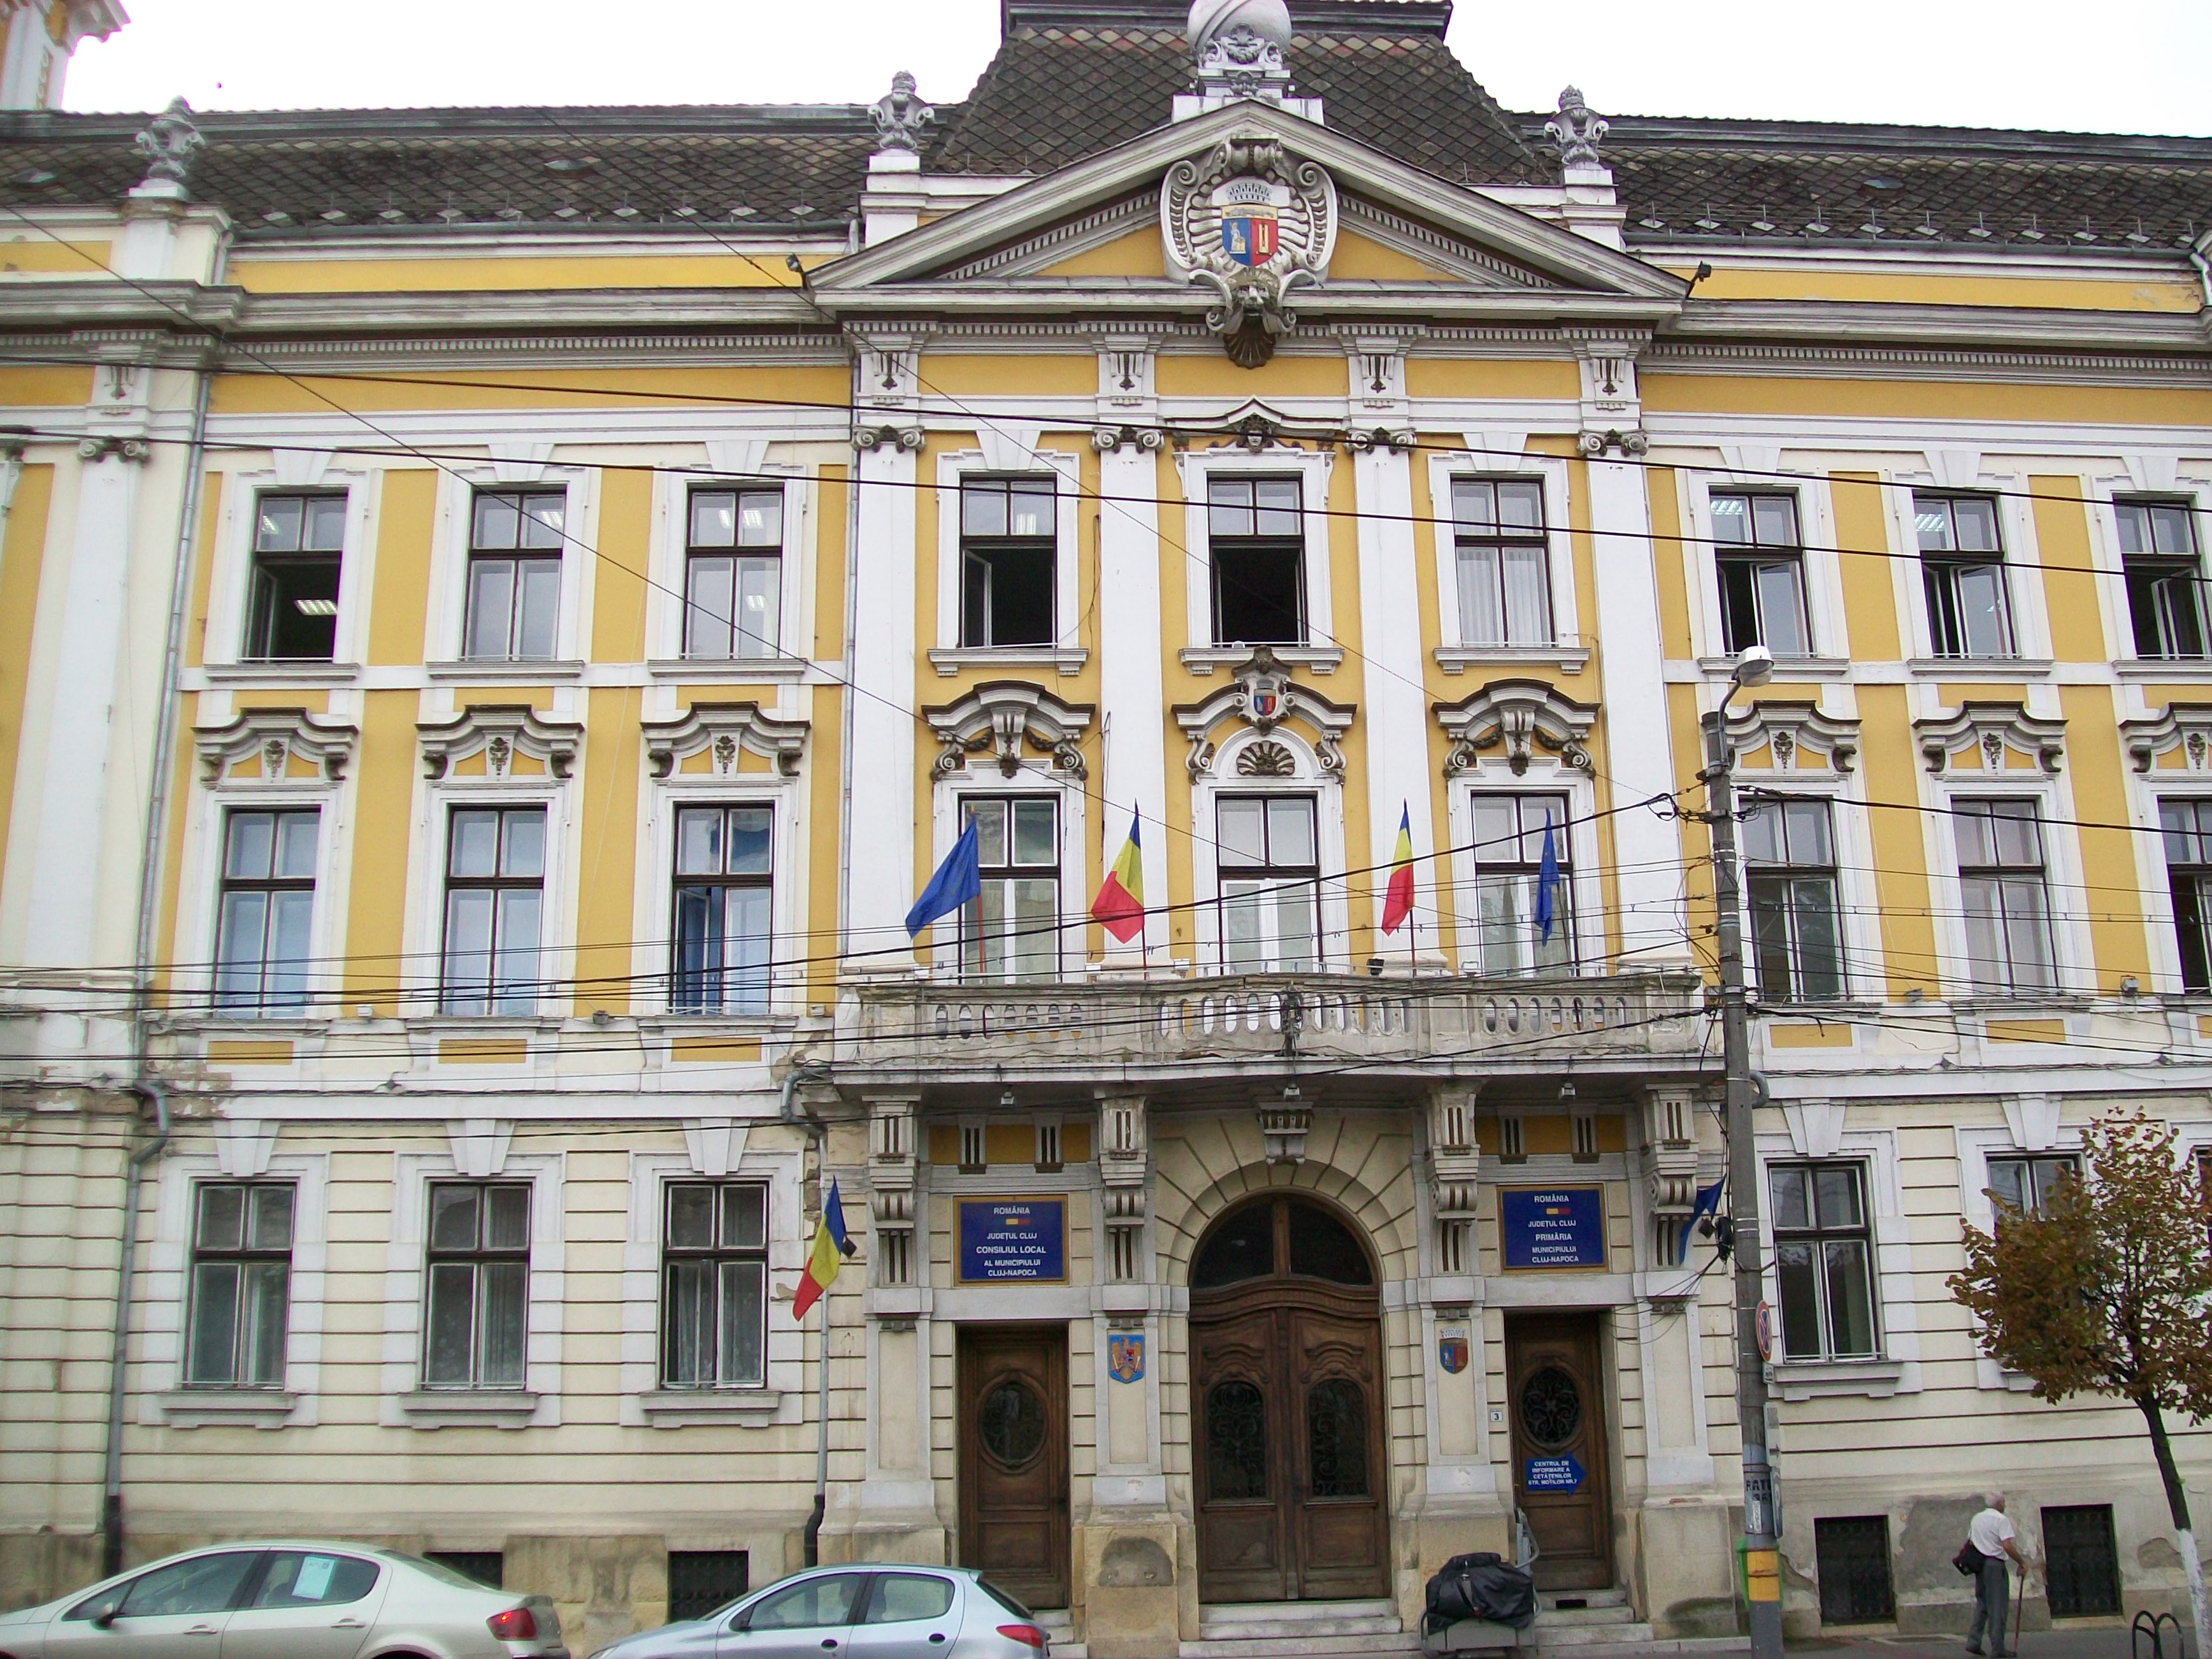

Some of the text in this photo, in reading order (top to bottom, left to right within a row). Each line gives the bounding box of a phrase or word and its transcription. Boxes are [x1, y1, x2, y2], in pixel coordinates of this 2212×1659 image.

[1534, 1193, 1569, 1203] ROMÂNIA
[993, 1205, 1030, 1214] ROMÂNIA
[1535, 1232, 1572, 1241] PRIMĂRIA
